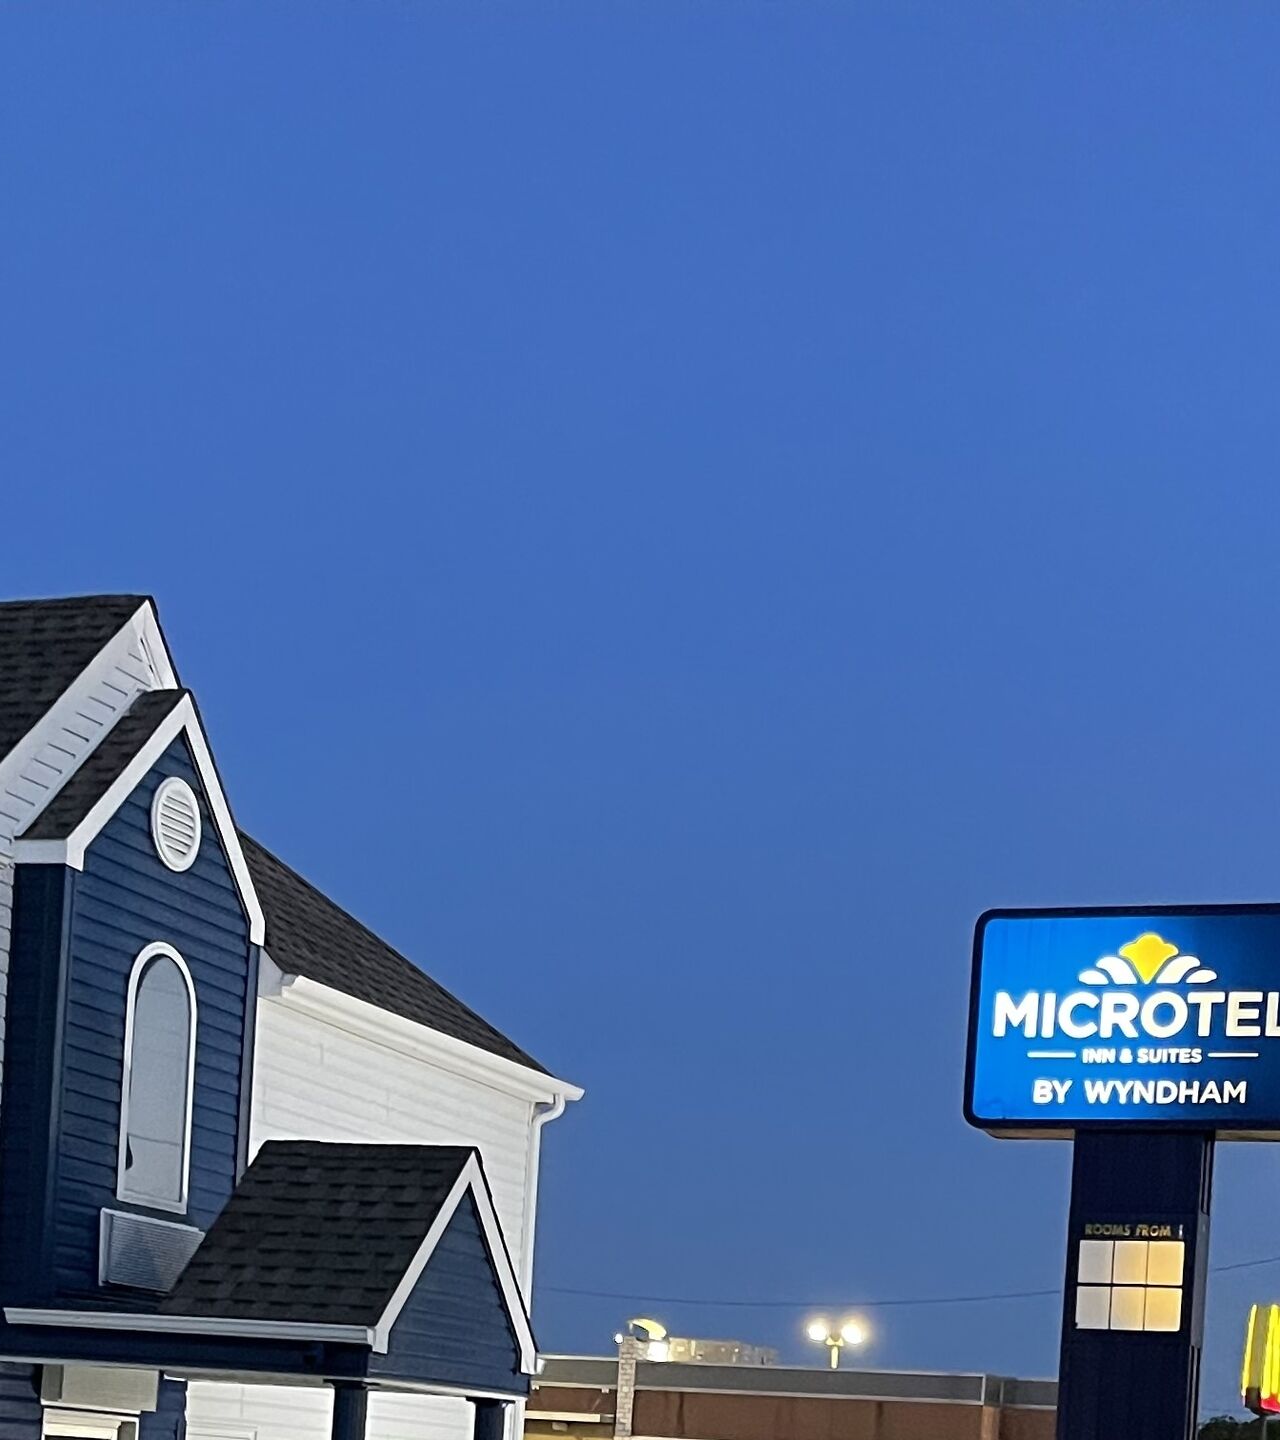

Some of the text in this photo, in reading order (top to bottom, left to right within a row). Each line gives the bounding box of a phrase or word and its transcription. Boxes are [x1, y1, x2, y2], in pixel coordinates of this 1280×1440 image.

[1082, 1048, 1202, 1064] INN & SUITES
[1032, 1079, 1247, 1104] BY WYNDHAM
[1084, 1223, 1131, 1236] ROOMS
[1135, 1224, 1172, 1237] FROM
